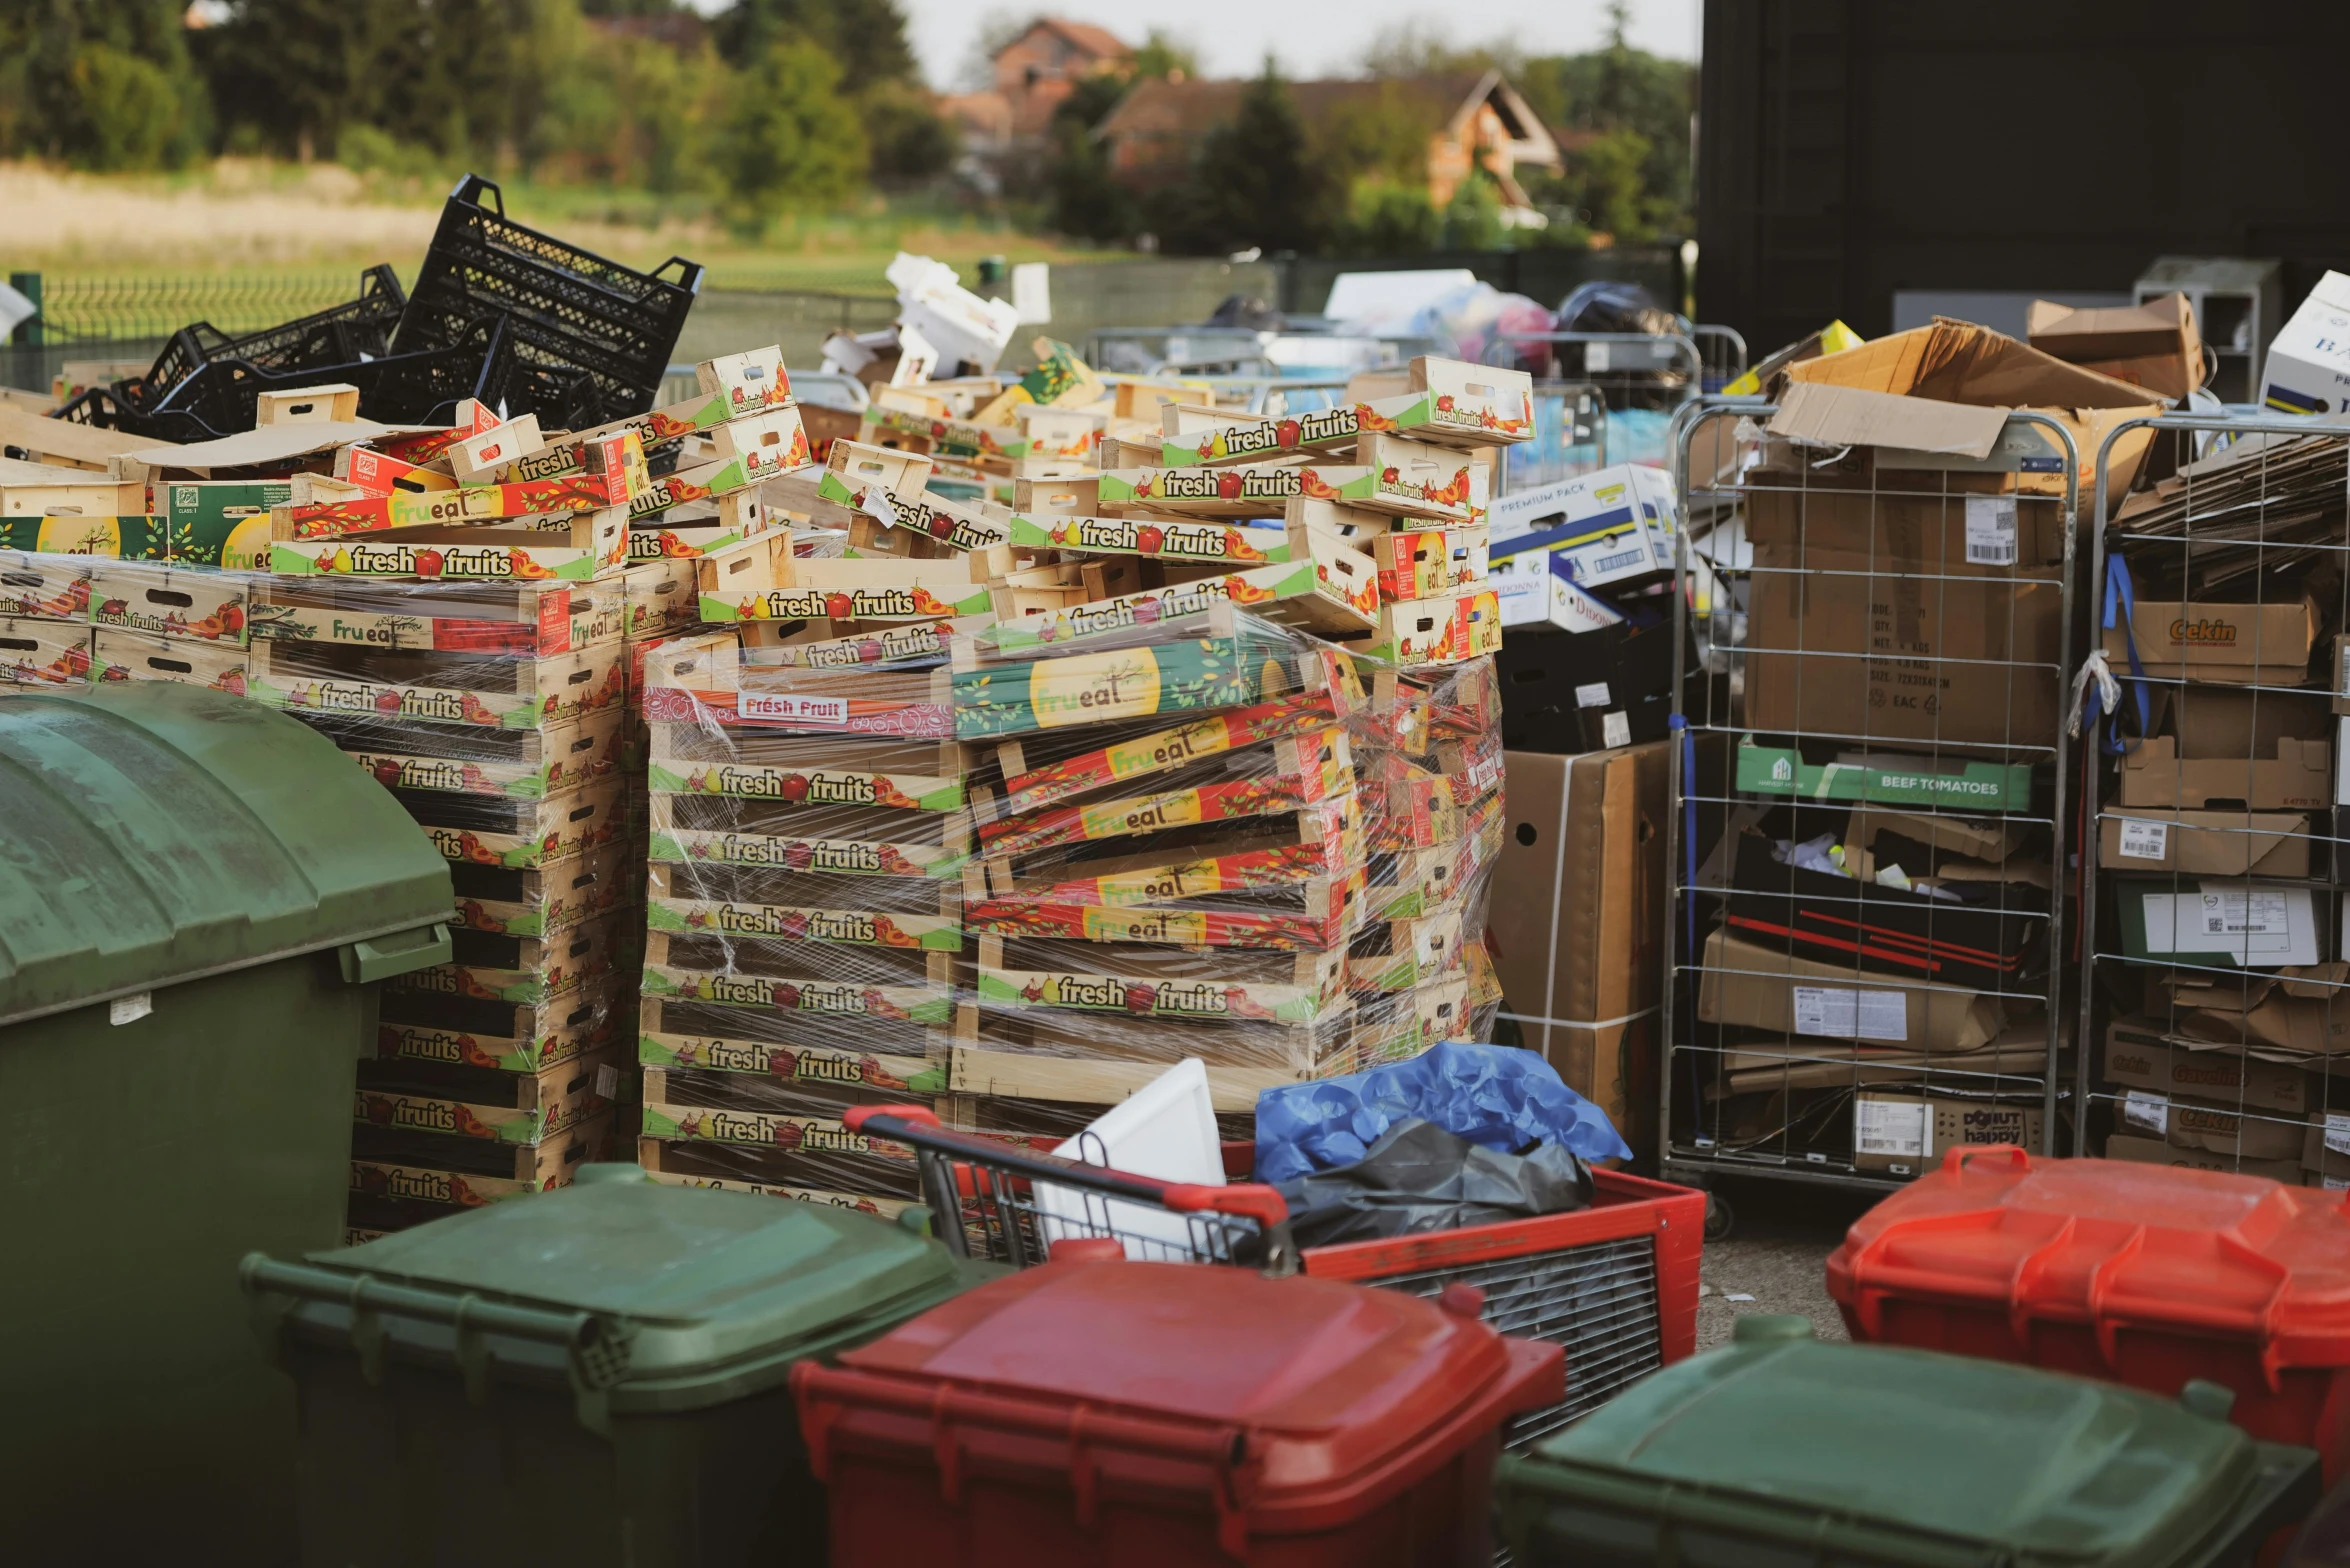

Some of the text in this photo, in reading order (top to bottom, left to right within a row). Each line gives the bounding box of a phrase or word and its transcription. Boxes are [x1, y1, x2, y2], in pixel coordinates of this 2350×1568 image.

[1225, 411, 1359, 453] fresh fruits
[1435, 406, 1482, 427] fresh fruits
[518, 445, 576, 482] fresh
[1164, 470, 1302, 497] fresh fruits
[1379, 479, 1424, 500] fresh fruits
[1501, 483, 1586, 513] PREMIUM PACK
[629, 486, 673, 516] ruits
[1081, 520, 1226, 556] fresh fruits
[352, 545, 513, 576] fresh fruits
[1499, 581, 1540, 593] IDONNA
[769, 589, 915, 617] fresh fruits
[1071, 584, 1230, 636] fresh fruits
[1576, 596, 1614, 626] DIDON
[97, 609, 164, 632] fresh fruits
[2170, 619, 2237, 641] Cekin
[806, 628, 940, 669] fresh fruits
[320, 682, 463, 720] fresh fruits
[800, 701, 840, 718] Fruit
[1893, 695, 1917, 709] EAC
[402, 760, 464, 789] fruits
[721, 767, 876, 803] fresh fruits
[1881, 775, 1999, 795] BEEF TOMATOES
[723, 835, 881, 871] fresh fruits
[719, 905, 876, 941] fresh fruits
[711, 976, 866, 1014] fresh fruits
[1058, 976, 1227, 1013] fresh fruits
[400, 1029, 461, 1061] fruits
[708, 1041, 862, 1082] fresh fruits
[396, 1098, 456, 1130] fruits
[713, 1114, 869, 1152] fresh fruits
[1964, 1128, 2021, 1145] happy
[390, 1168, 450, 1200] fruits
